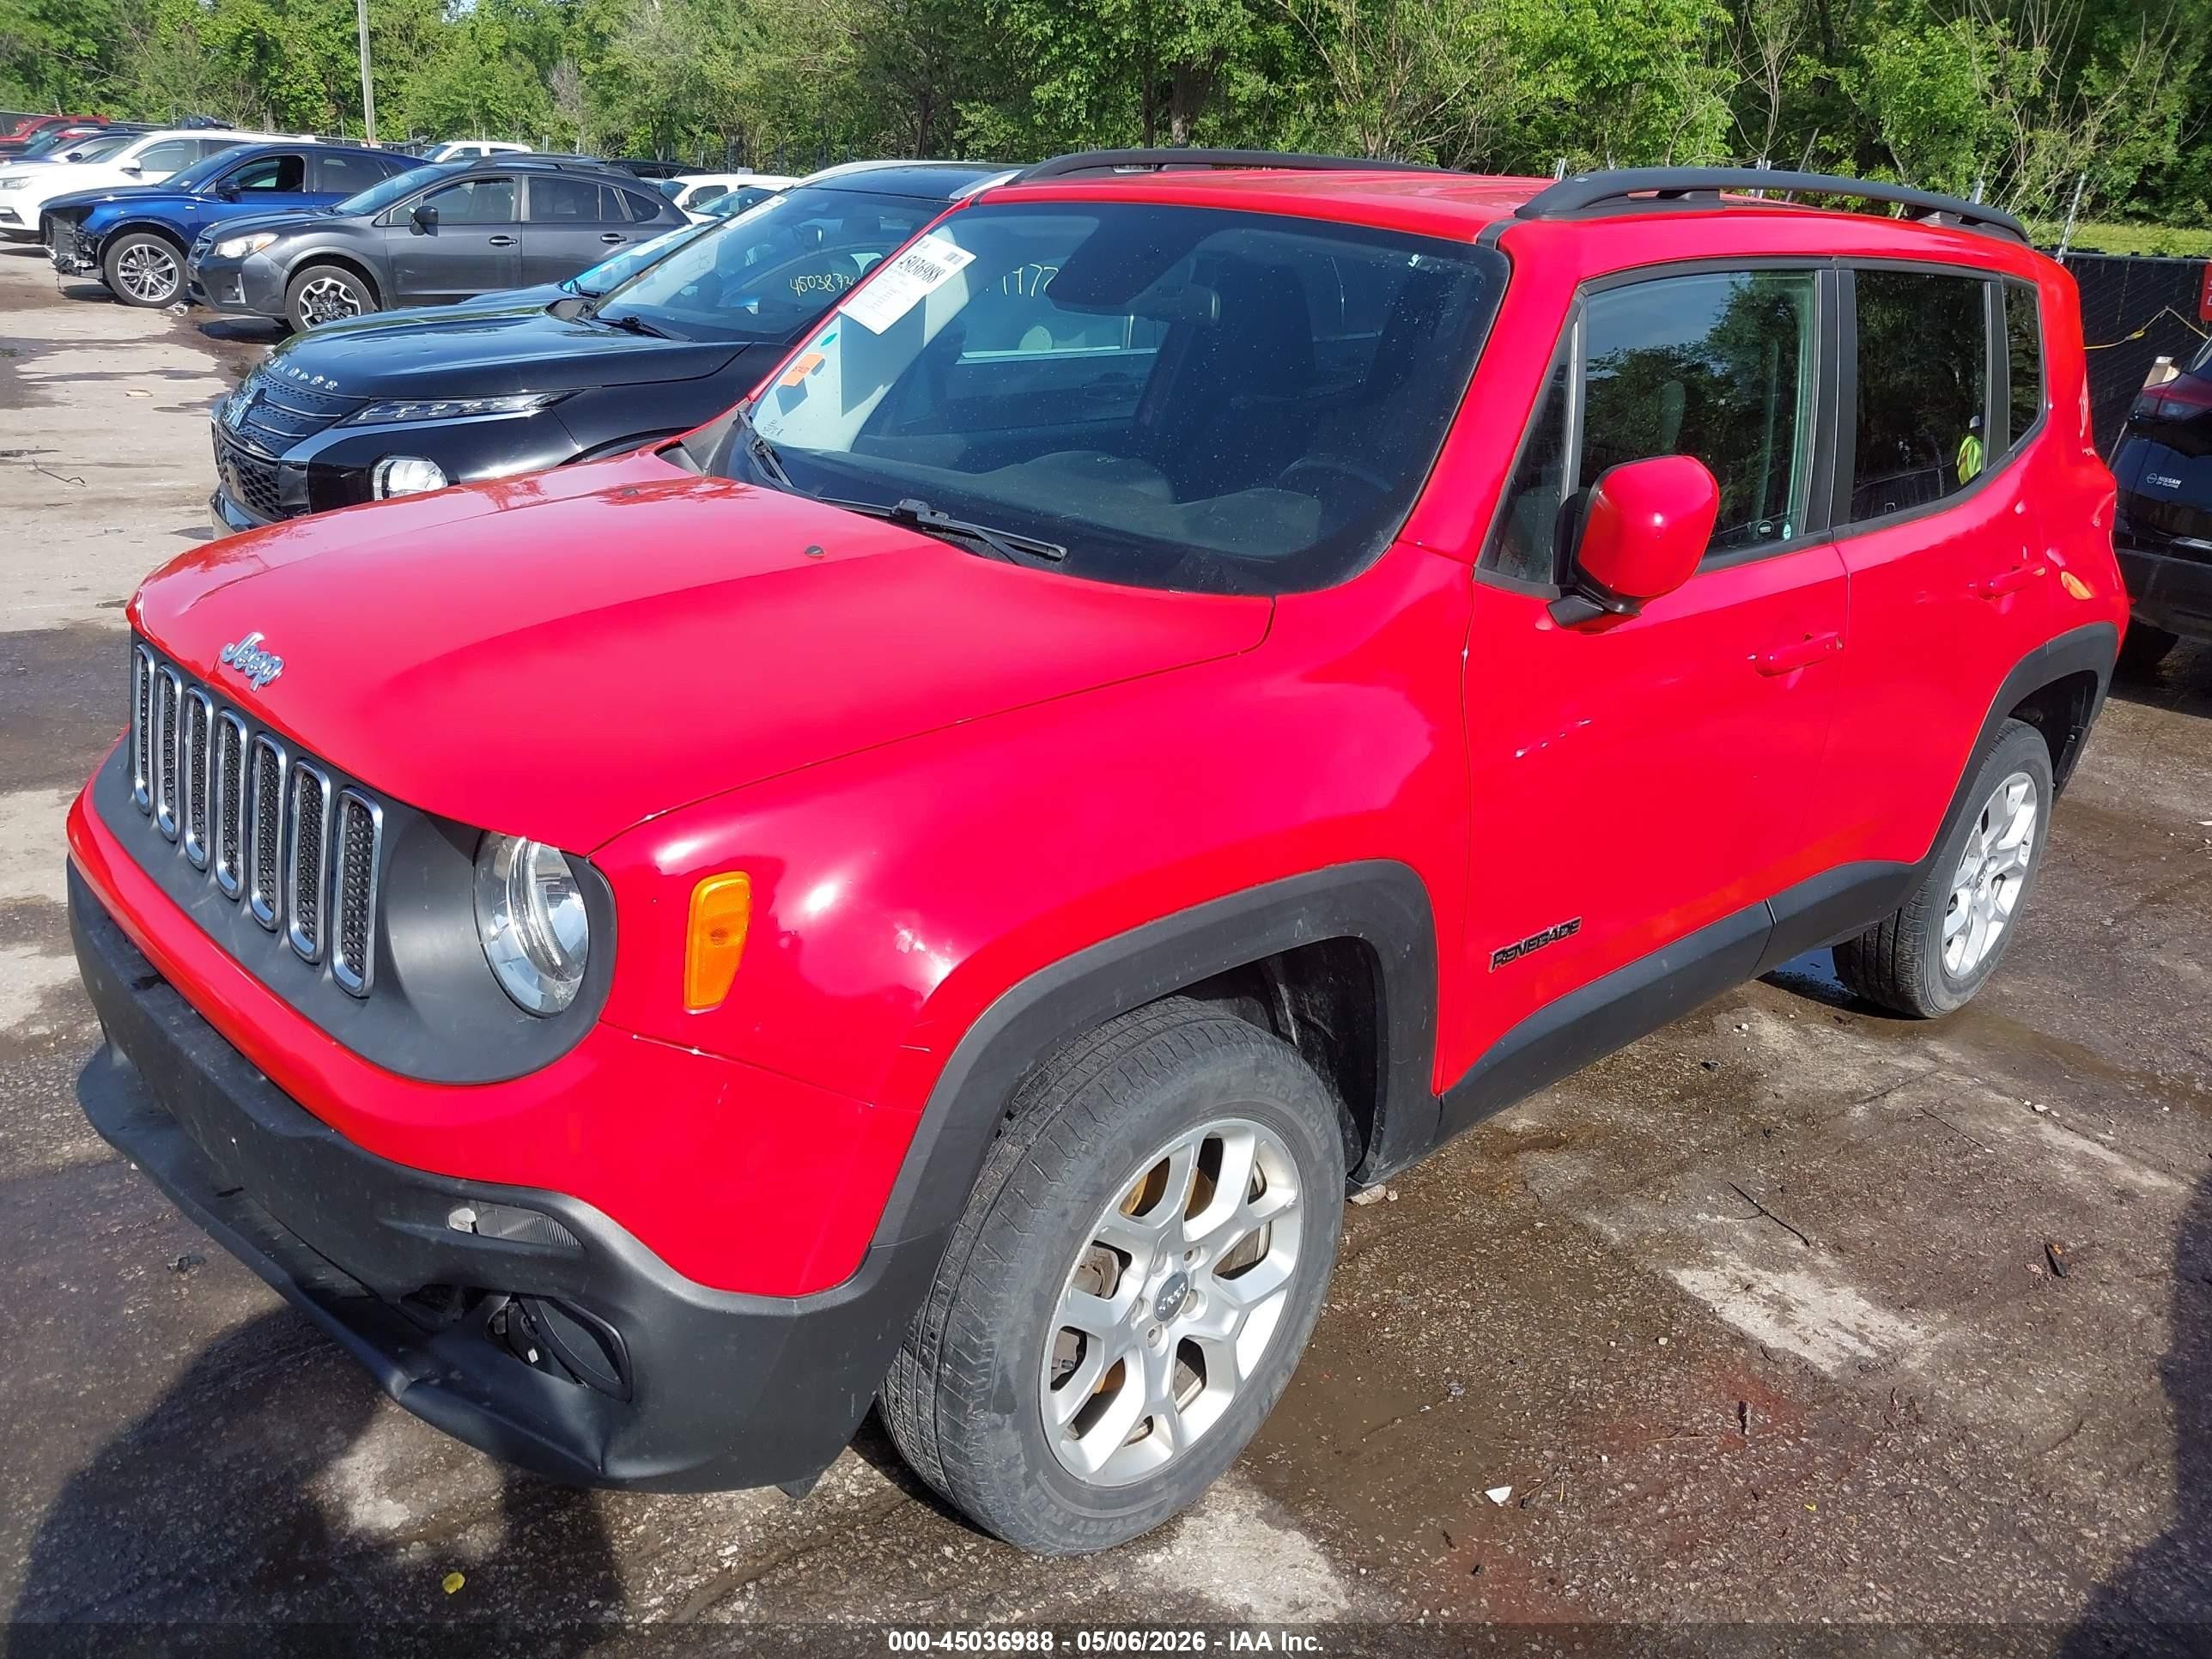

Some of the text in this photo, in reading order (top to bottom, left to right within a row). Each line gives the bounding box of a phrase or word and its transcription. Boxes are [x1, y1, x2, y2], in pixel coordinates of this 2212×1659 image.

[2157, 476, 2182, 485] NISSAN
[222, 632, 285, 692] Jeep
[1490, 916, 1582, 972] RENEGADE
